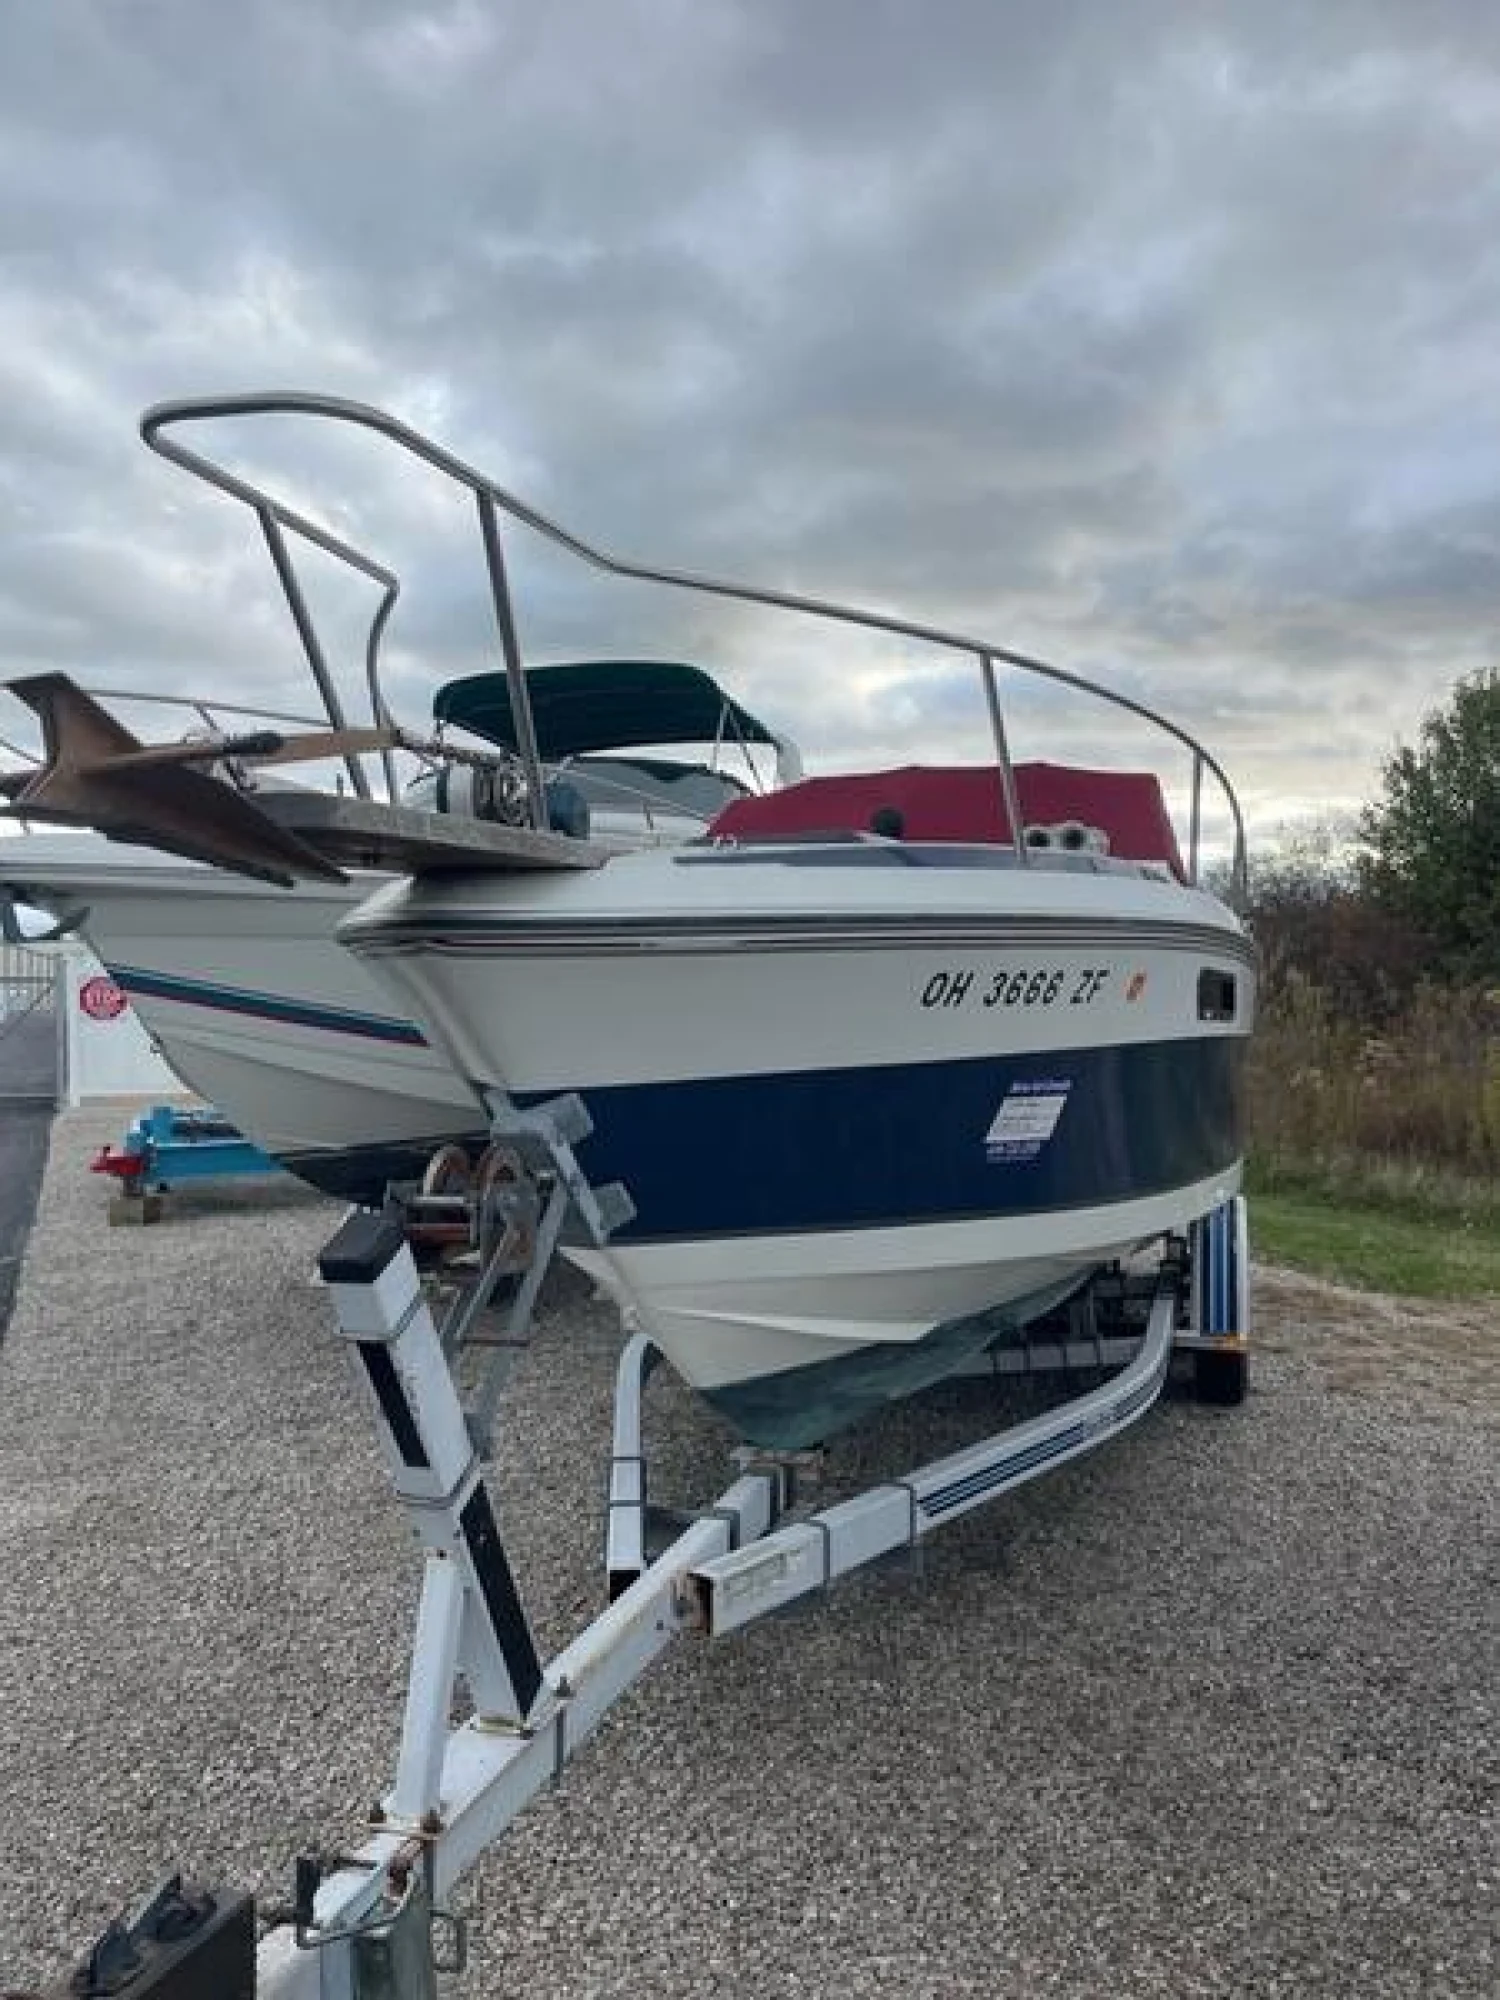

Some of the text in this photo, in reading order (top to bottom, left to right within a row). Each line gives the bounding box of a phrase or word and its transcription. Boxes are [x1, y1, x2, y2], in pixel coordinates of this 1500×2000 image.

[920, 971, 973, 1007] OH
[983, 970, 1064, 1007] 3666
[1070, 968, 1110, 1004] ZF
